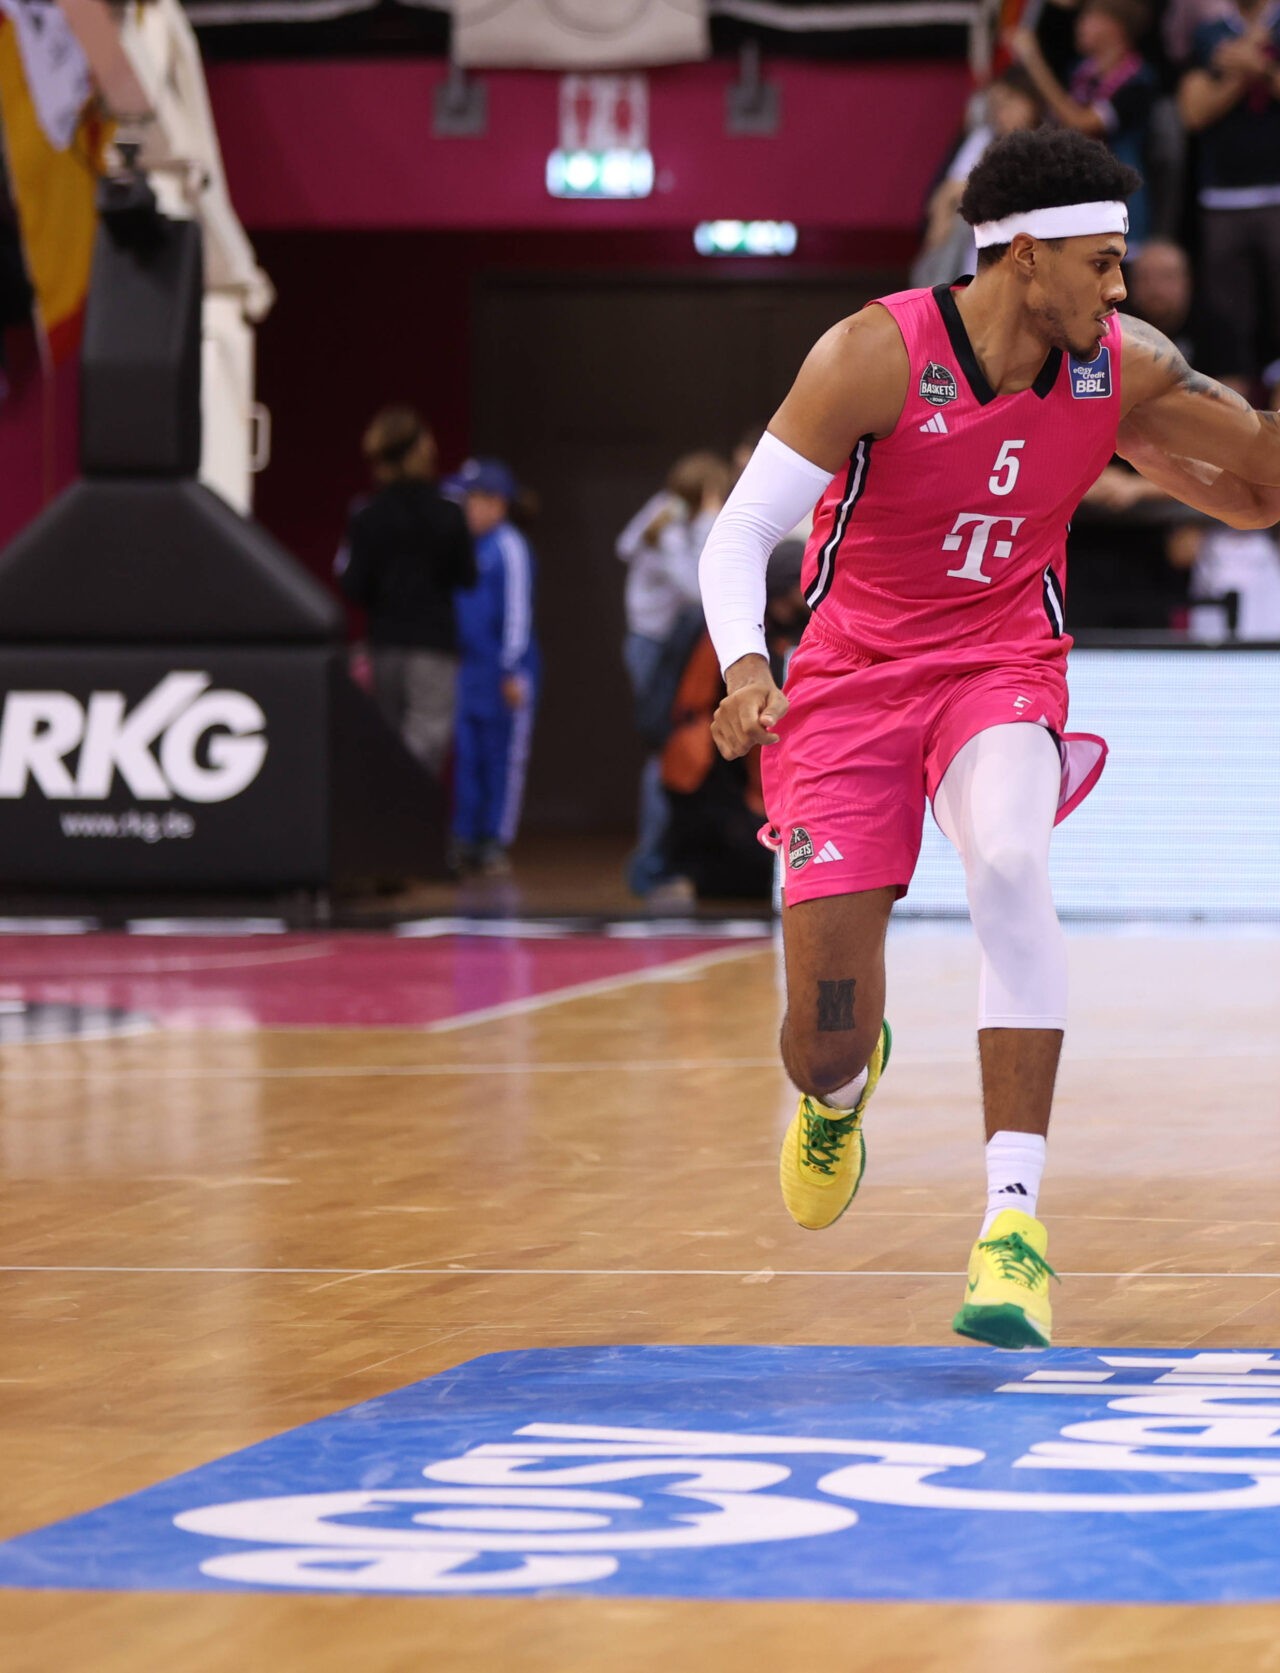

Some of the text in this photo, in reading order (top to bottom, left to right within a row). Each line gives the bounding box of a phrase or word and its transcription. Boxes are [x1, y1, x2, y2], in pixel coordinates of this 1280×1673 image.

[921, 382, 955, 396] BASKETS
[1075, 379, 1106, 393] BBL
[988, 439, 1026, 496] 5
[941, 512, 1026, 584] T
[0, 670, 269, 803] RKG
[60, 808, 196, 844] www.rkg.de
